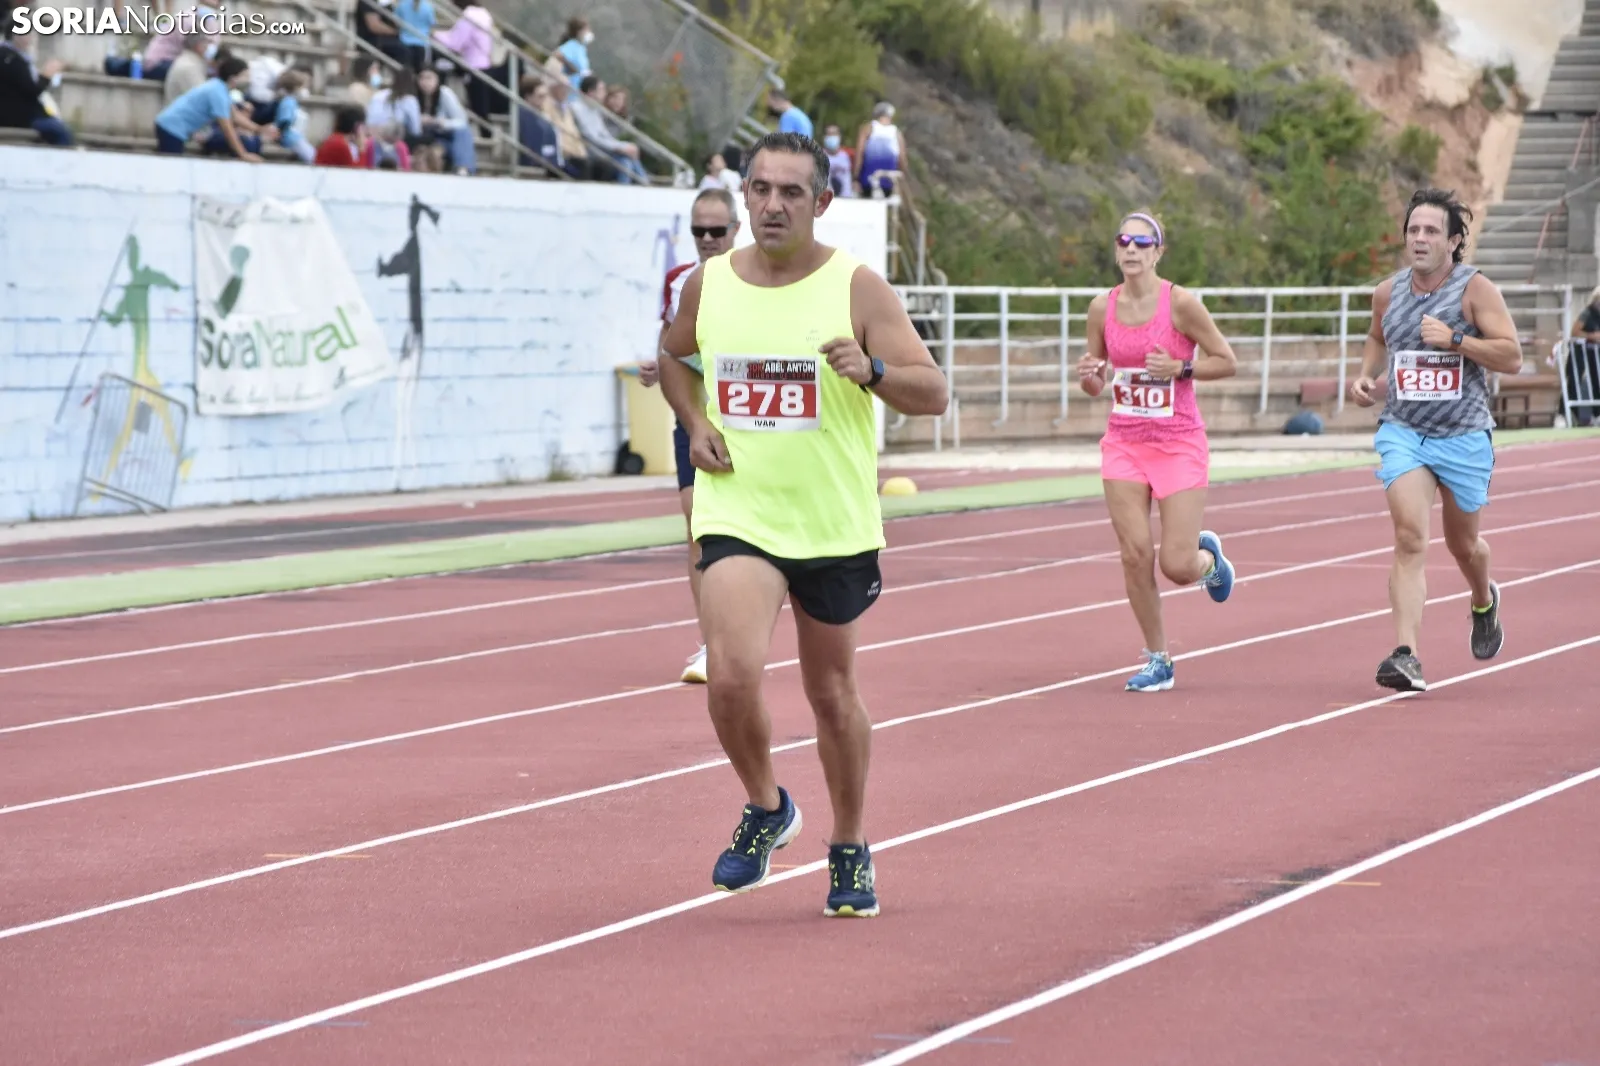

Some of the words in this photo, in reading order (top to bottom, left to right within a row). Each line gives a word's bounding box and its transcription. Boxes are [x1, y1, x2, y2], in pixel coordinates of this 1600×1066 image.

[765, 361, 785, 374] ABEL
[1402, 370, 1454, 391] 280
[727, 383, 805, 416] 278
[1119, 385, 1164, 407] 310
